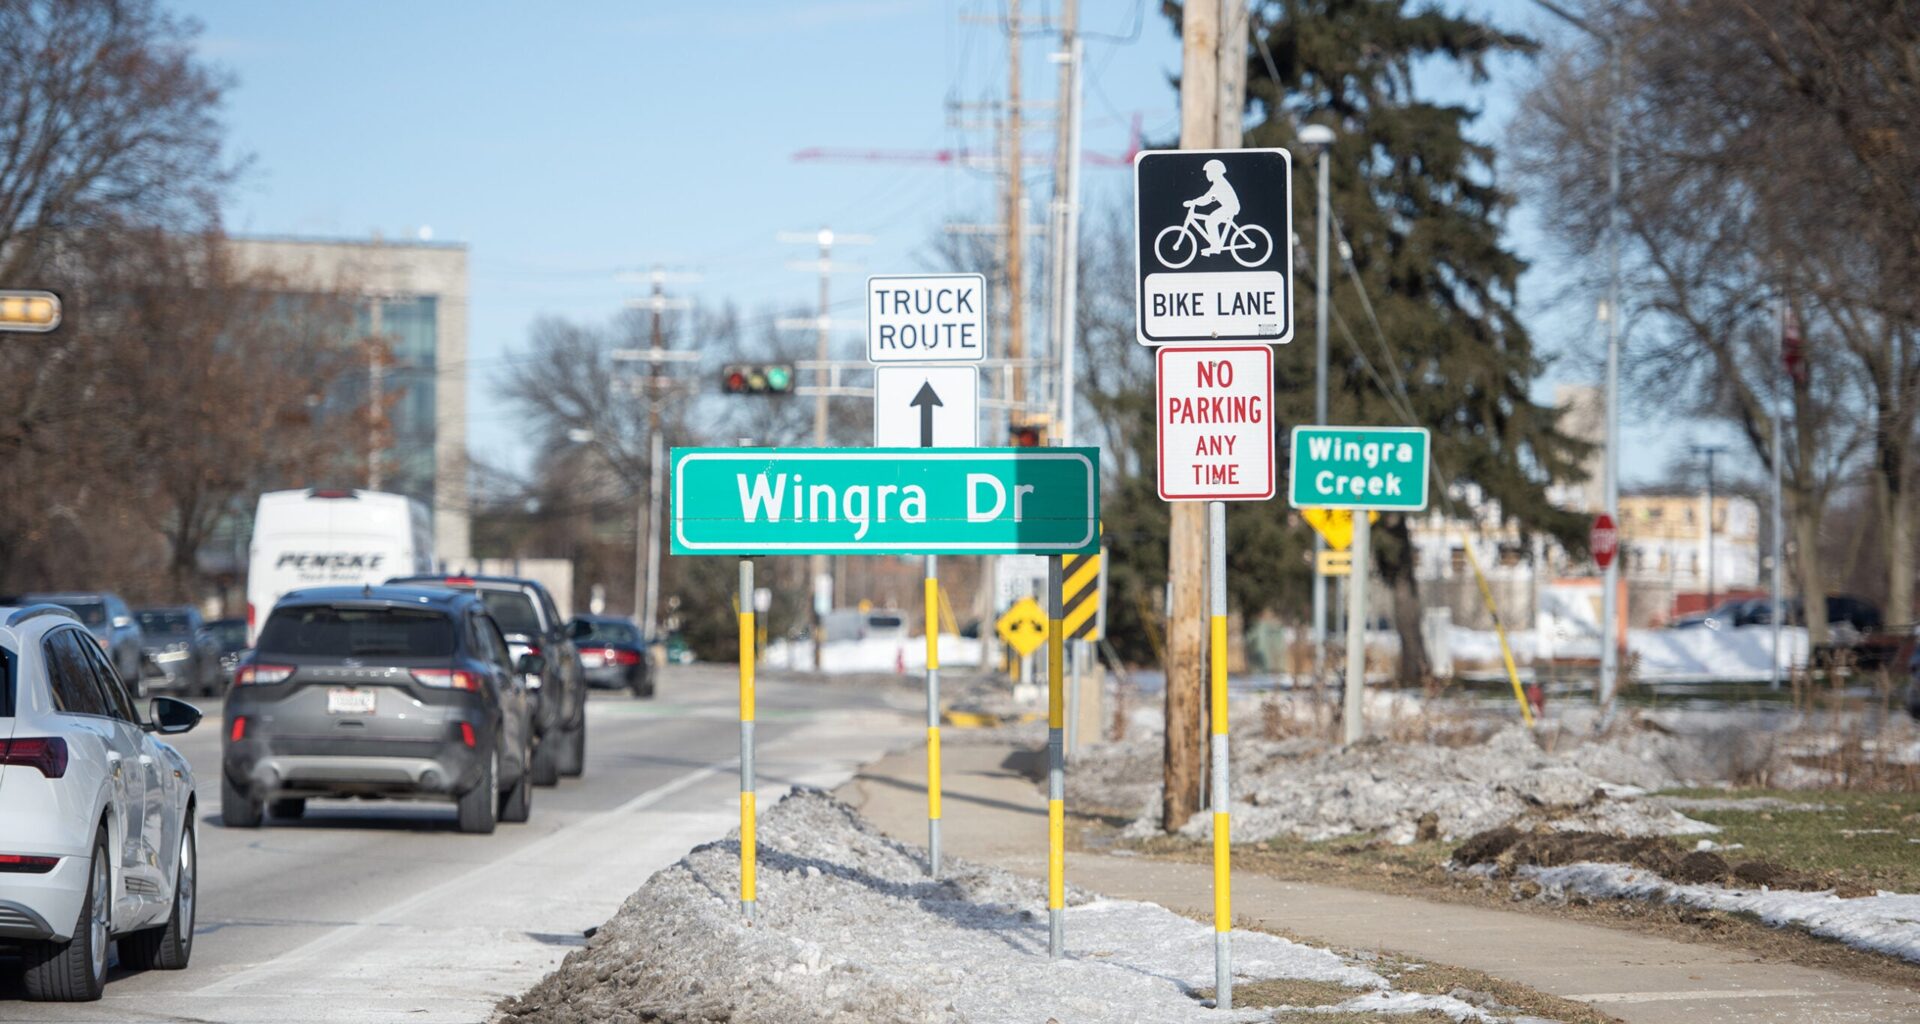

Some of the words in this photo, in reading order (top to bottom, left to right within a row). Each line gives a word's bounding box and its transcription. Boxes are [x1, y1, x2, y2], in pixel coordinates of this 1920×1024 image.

[875, 288, 973, 315] TRUCK
[1153, 292, 1205, 317] BIKE
[1217, 291, 1276, 316] LANE
[880, 323, 976, 349] ROUTE
[1197, 360, 1233, 388] NO
[1169, 396, 1262, 424] PARKING
[1196, 435, 1237, 455] ANY
[1308, 437, 1413, 467] Wingra
[1193, 463, 1239, 485] TIME
[1315, 470, 1402, 496] Creek
[736, 472, 927, 541] Wingra
[966, 472, 1035, 523] Dr
[1592, 529, 1617, 553] STOP
[276, 552, 384, 568] PENSKE
